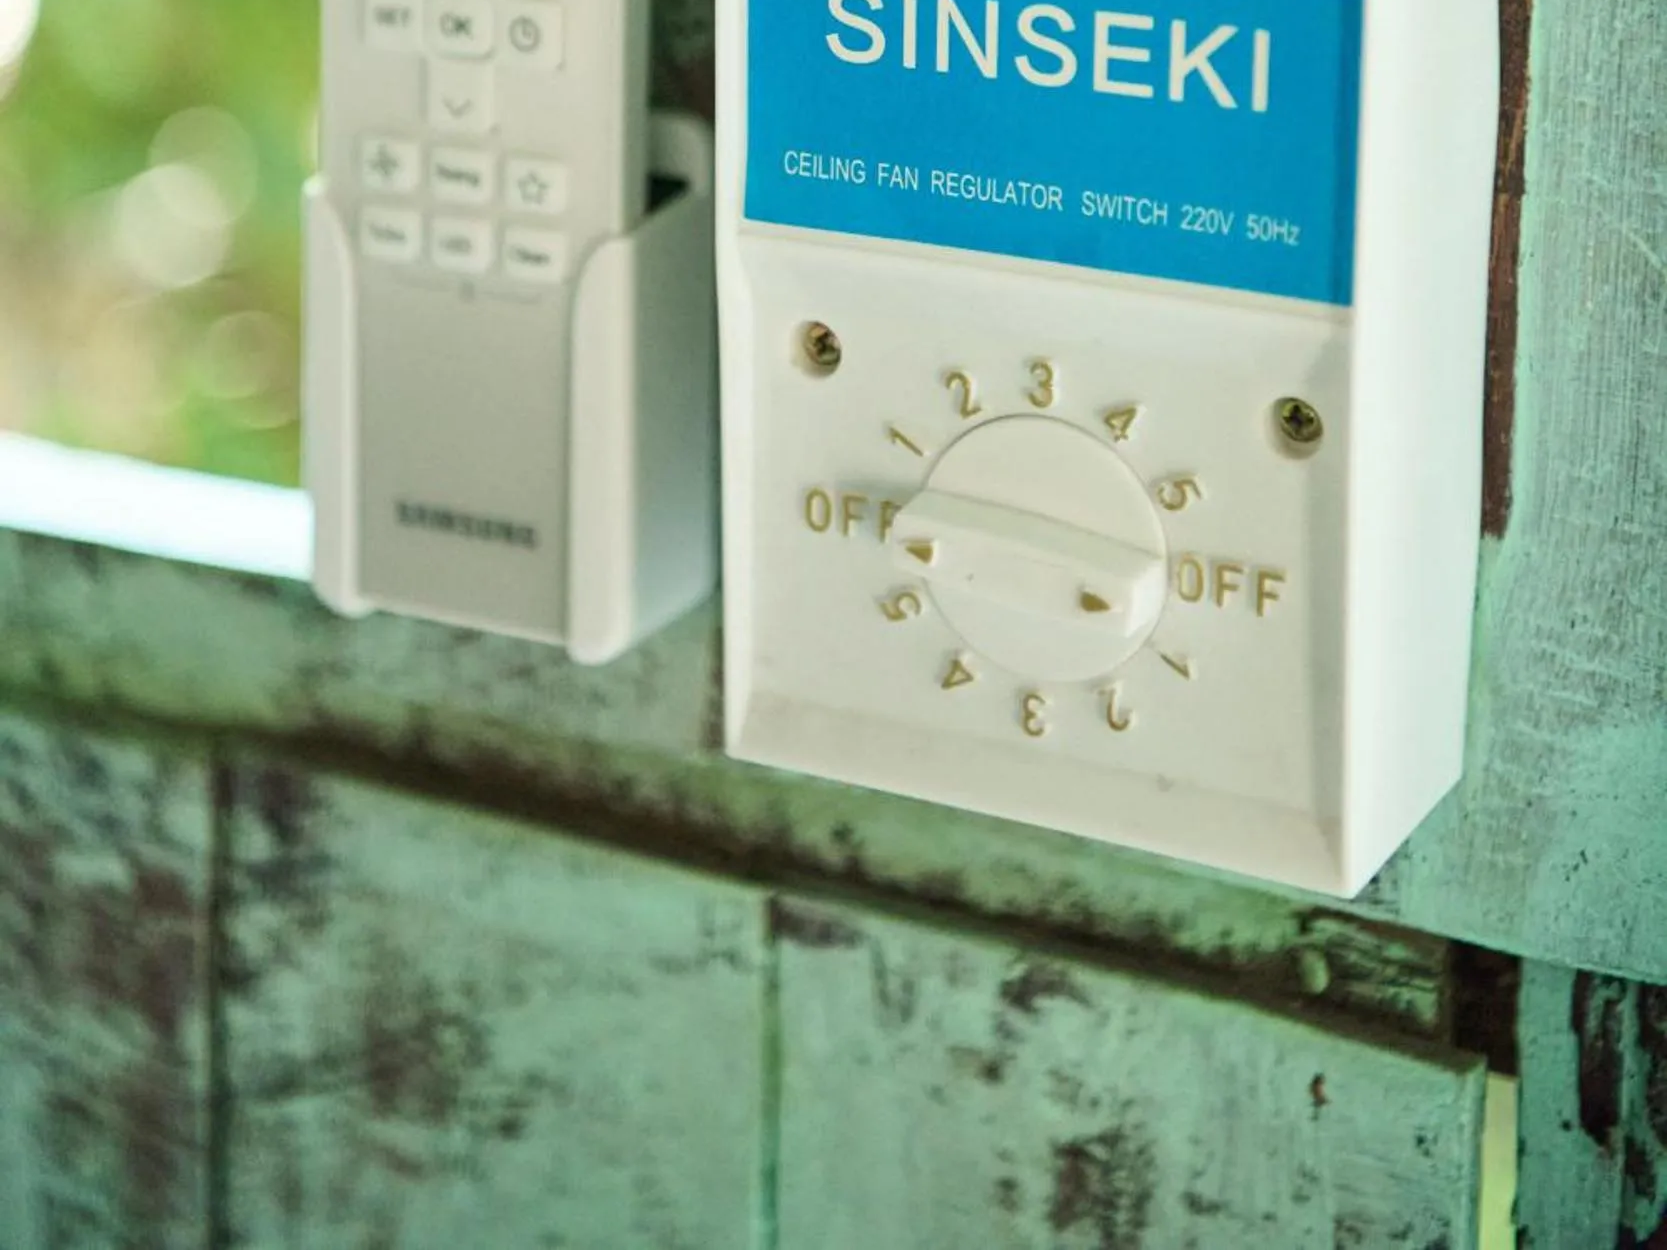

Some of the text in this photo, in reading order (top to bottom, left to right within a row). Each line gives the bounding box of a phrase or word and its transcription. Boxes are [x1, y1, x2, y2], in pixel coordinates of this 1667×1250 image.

[784, 150, 1301, 247] CEILING FAN REGULATOR SWITCH 220V 50Hz
[944, 371, 982, 419] 2
[1027, 360, 1056, 408] 3
[885, 425, 924, 457] 1
[1104, 405, 1139, 441] 4
[1156, 473, 1204, 512] 5
[880, 591, 921, 622] 5
[1176, 558, 1286, 617] OFF
[940, 652, 974, 690] 4
[1160, 651, 1192, 681] 1
[1020, 692, 1048, 738] 3
